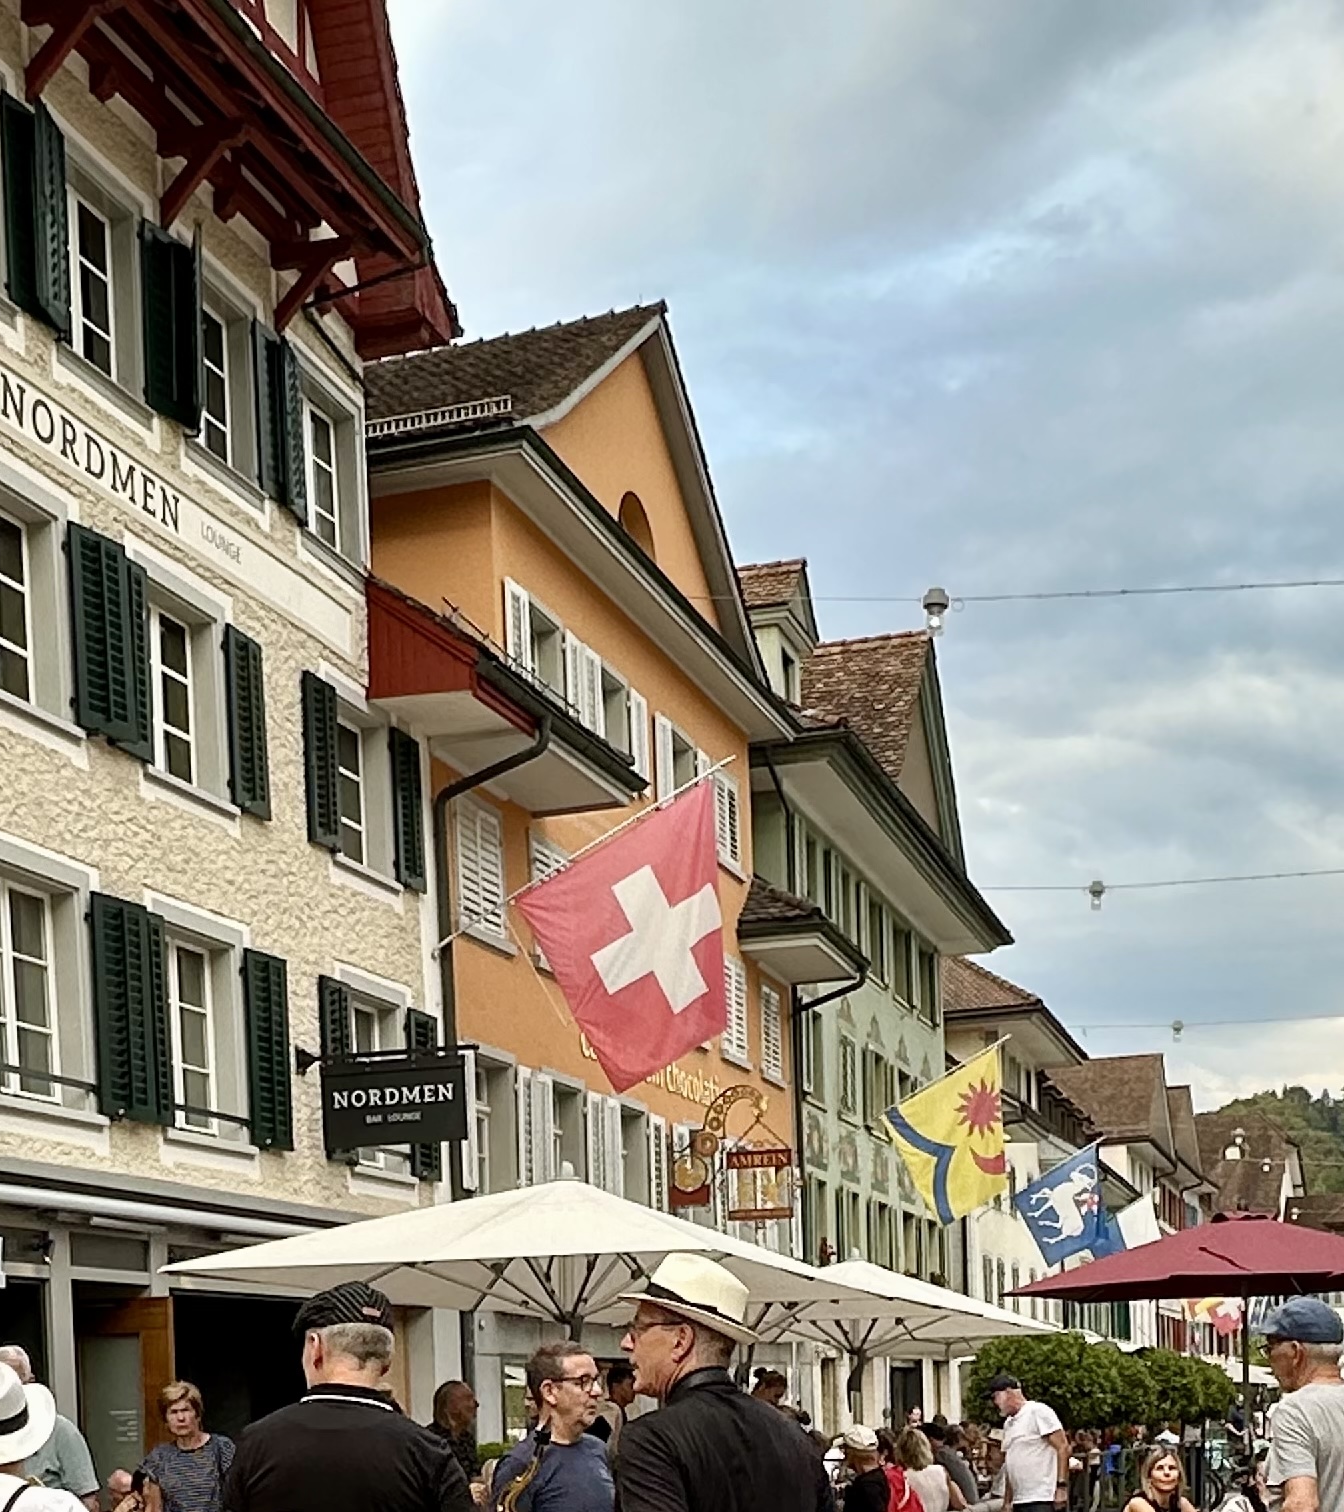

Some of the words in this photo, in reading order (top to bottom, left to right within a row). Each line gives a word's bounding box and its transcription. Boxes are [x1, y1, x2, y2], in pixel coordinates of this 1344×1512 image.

[0, 371, 180, 534] NORDMEN
[201, 520, 242, 565] LOUNGE
[332, 1082, 454, 1109] NORDMEN
